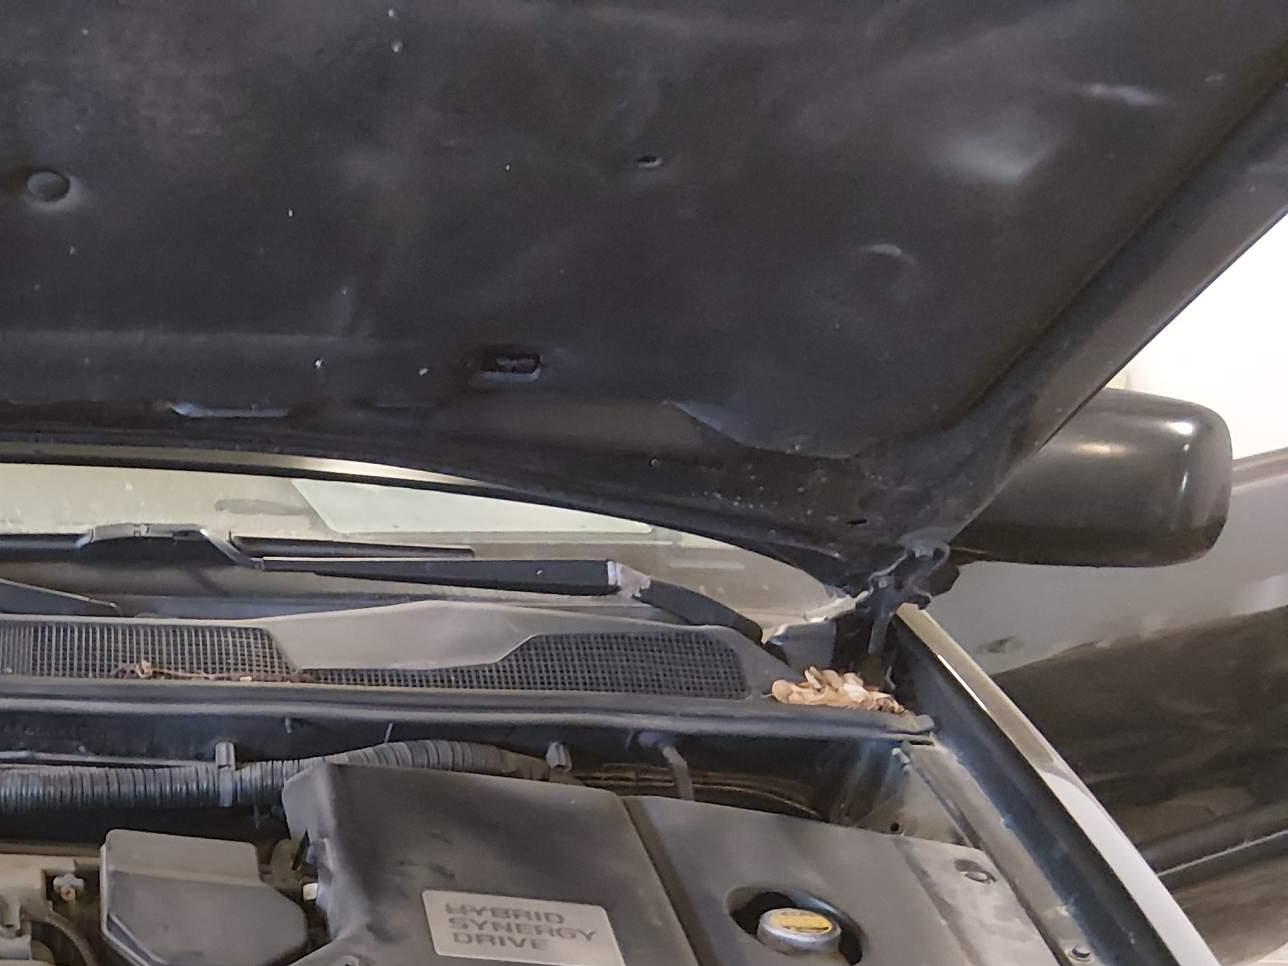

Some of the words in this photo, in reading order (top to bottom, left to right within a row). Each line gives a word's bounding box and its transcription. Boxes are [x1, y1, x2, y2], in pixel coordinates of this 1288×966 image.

[445, 903, 565, 925] HYBRID
[448, 916, 596, 942] SYNERGY
[452, 931, 550, 949] DRIVE
